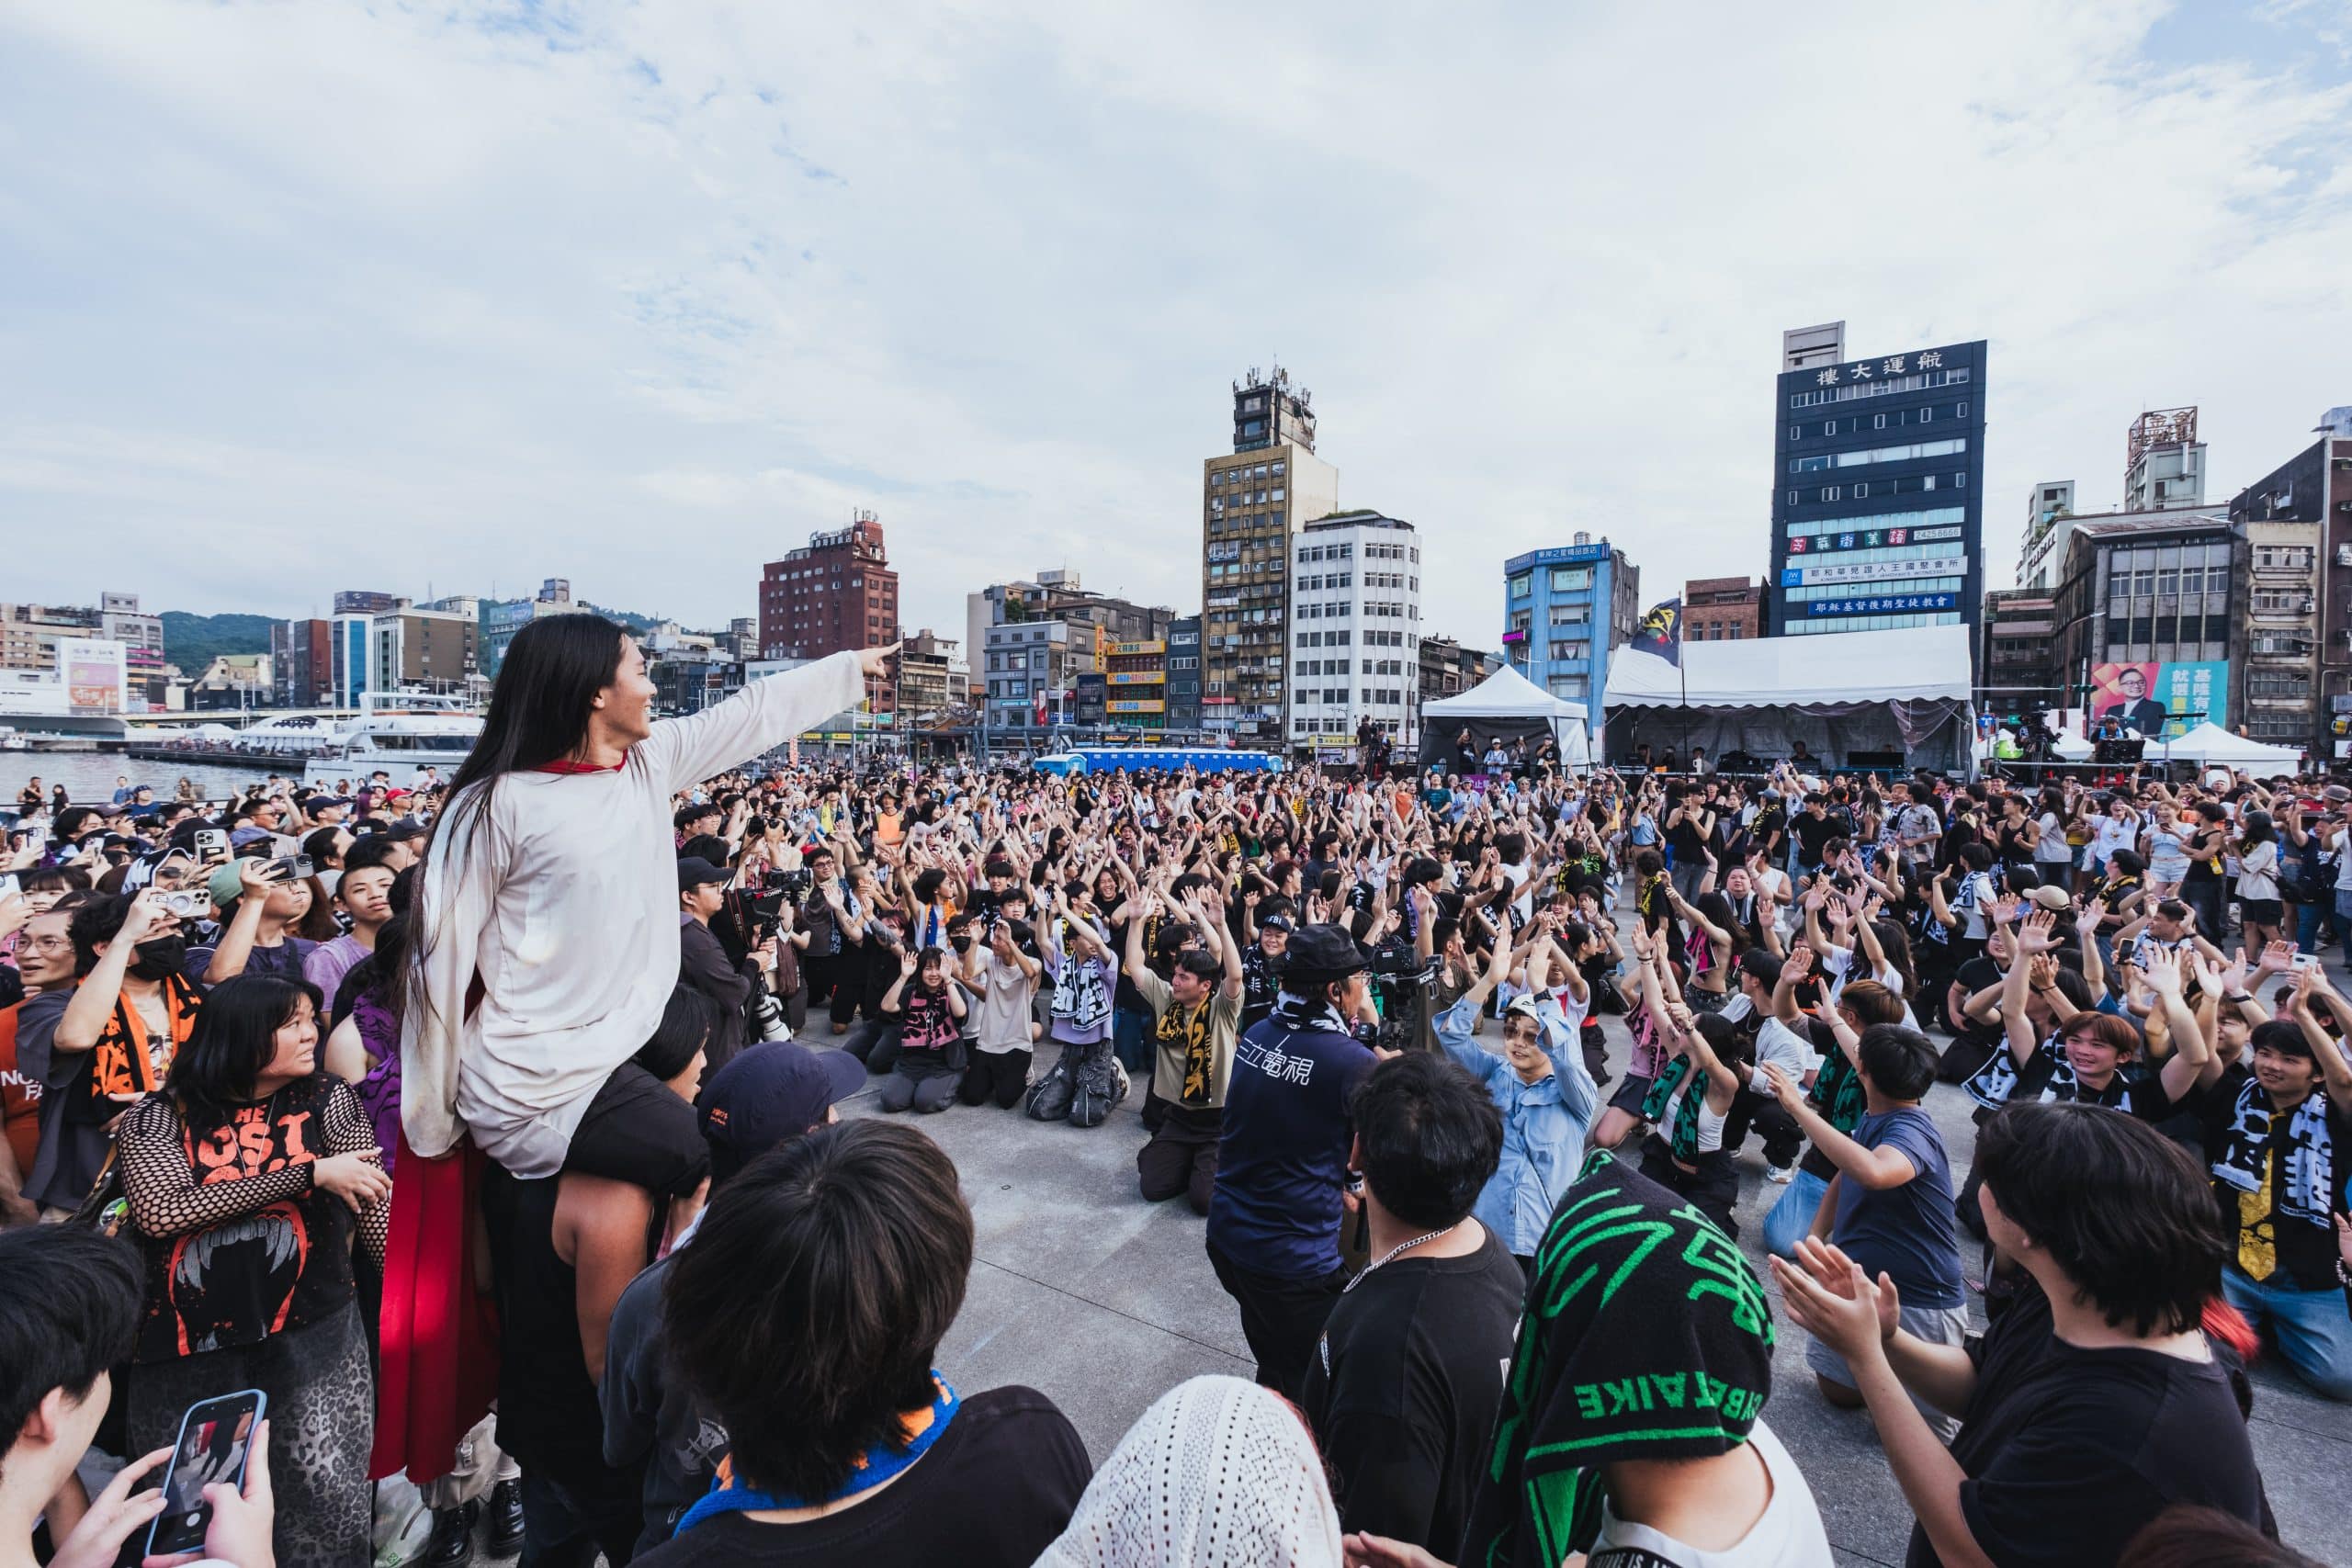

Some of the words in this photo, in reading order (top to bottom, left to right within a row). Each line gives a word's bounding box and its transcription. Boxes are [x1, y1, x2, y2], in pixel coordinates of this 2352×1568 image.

[1268, 915, 1283, 925] FBI
[1236, 1033, 1315, 1086] 三立電視
[234, 1104, 268, 1123] HE
